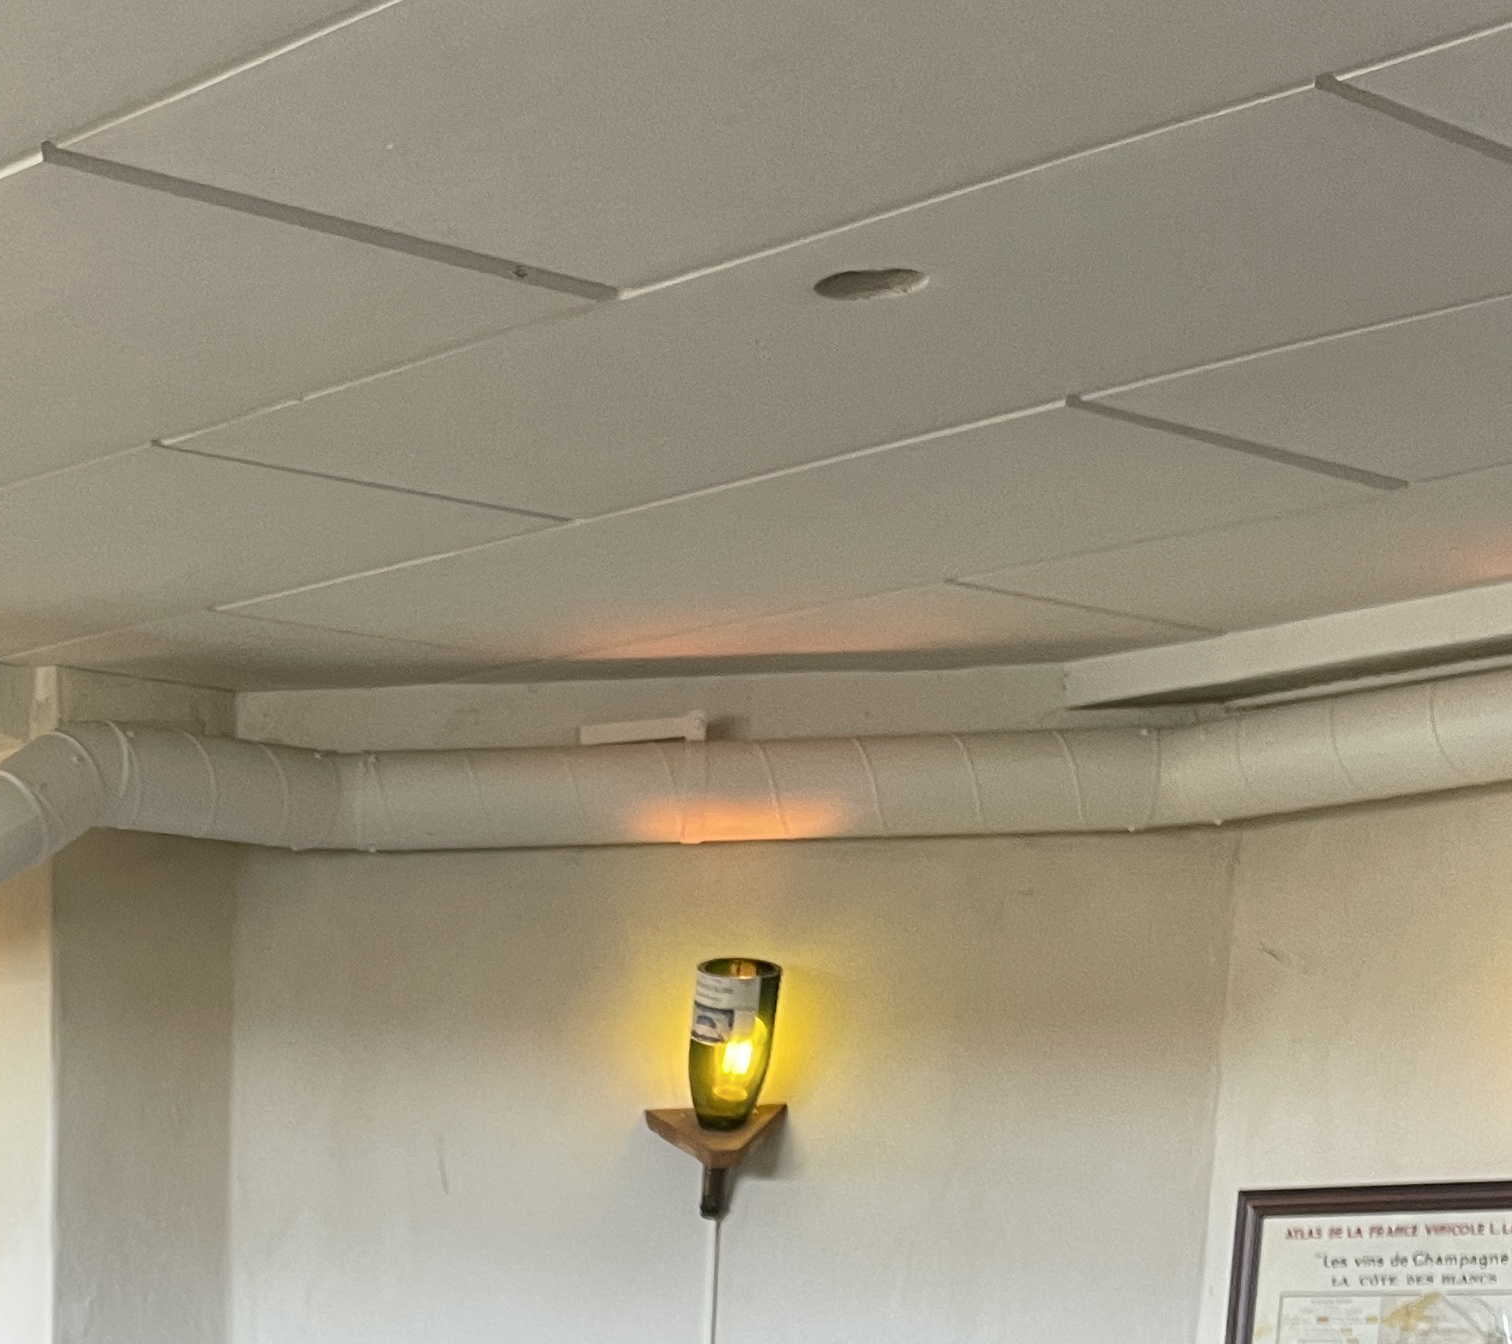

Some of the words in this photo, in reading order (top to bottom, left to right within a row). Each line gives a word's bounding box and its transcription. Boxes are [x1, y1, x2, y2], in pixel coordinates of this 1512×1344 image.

[1347, 1224, 1364, 1240] LA
[1368, 1223, 1418, 1239] FRANCE
[1354, 1253, 1385, 1269] vins
[1390, 1251, 1409, 1268] de
[1411, 1249, 1509, 1271] Champagne
